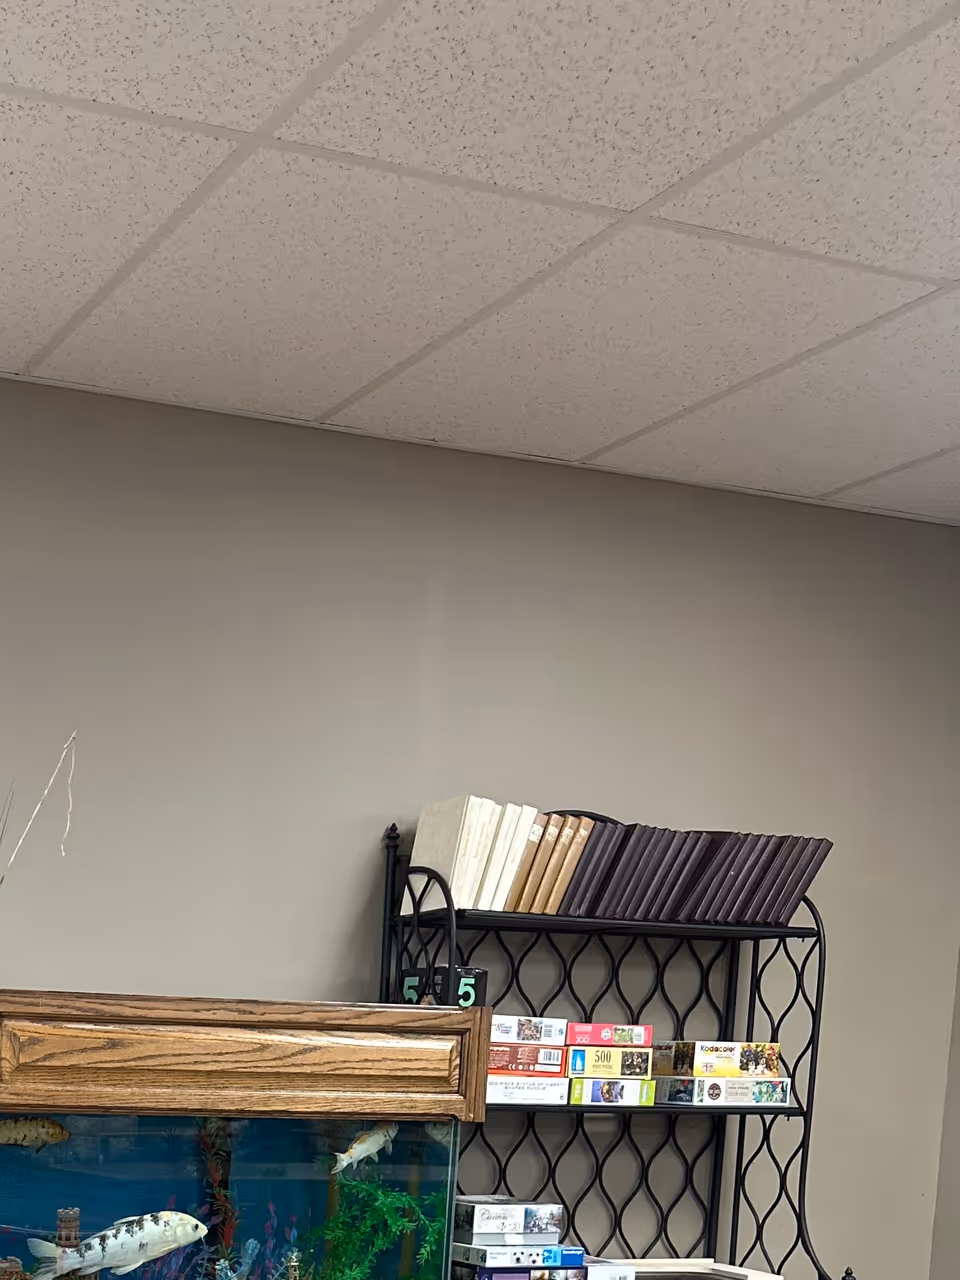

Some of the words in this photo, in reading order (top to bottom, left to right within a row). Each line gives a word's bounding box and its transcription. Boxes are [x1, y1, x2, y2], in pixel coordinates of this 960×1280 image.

[458, 977, 475, 1007] 5
[700, 1044, 736, 1053] Kodacolor
[594, 1050, 612, 1063] 500
